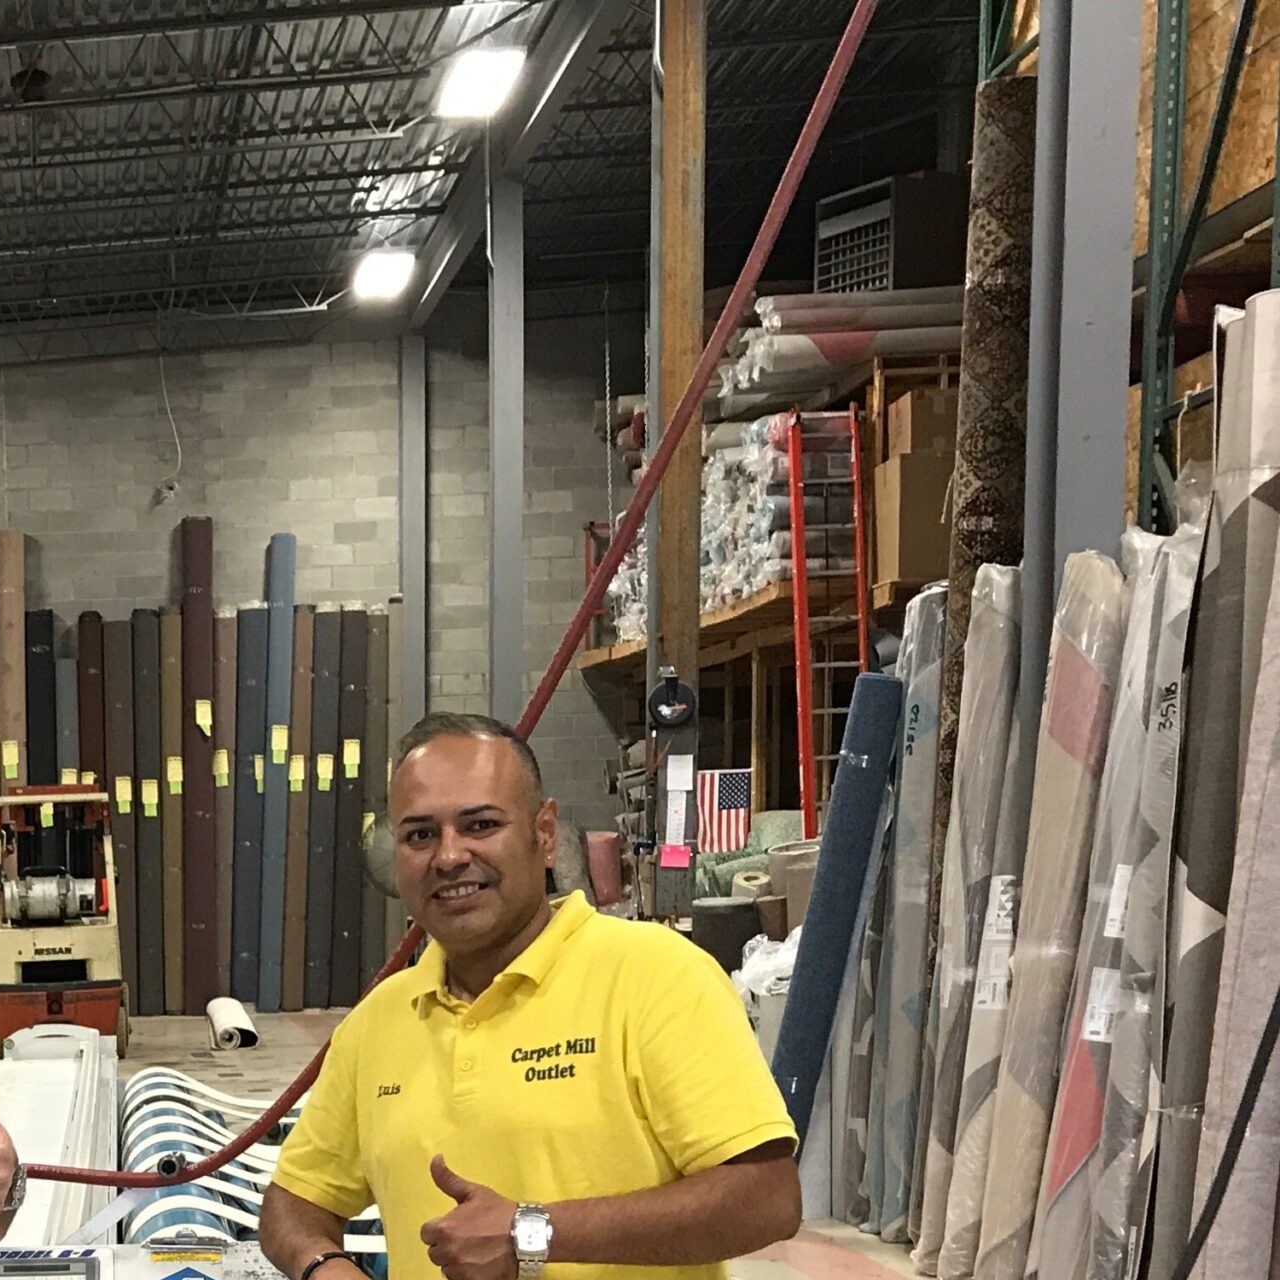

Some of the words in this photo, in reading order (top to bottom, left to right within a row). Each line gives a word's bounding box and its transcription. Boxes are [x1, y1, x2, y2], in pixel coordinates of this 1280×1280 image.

[34, 947, 72, 956] NISSAN
[511, 1042, 562, 1063] Carpet
[565, 1037, 596, 1056] Mill
[524, 1063, 576, 1083] Outlet
